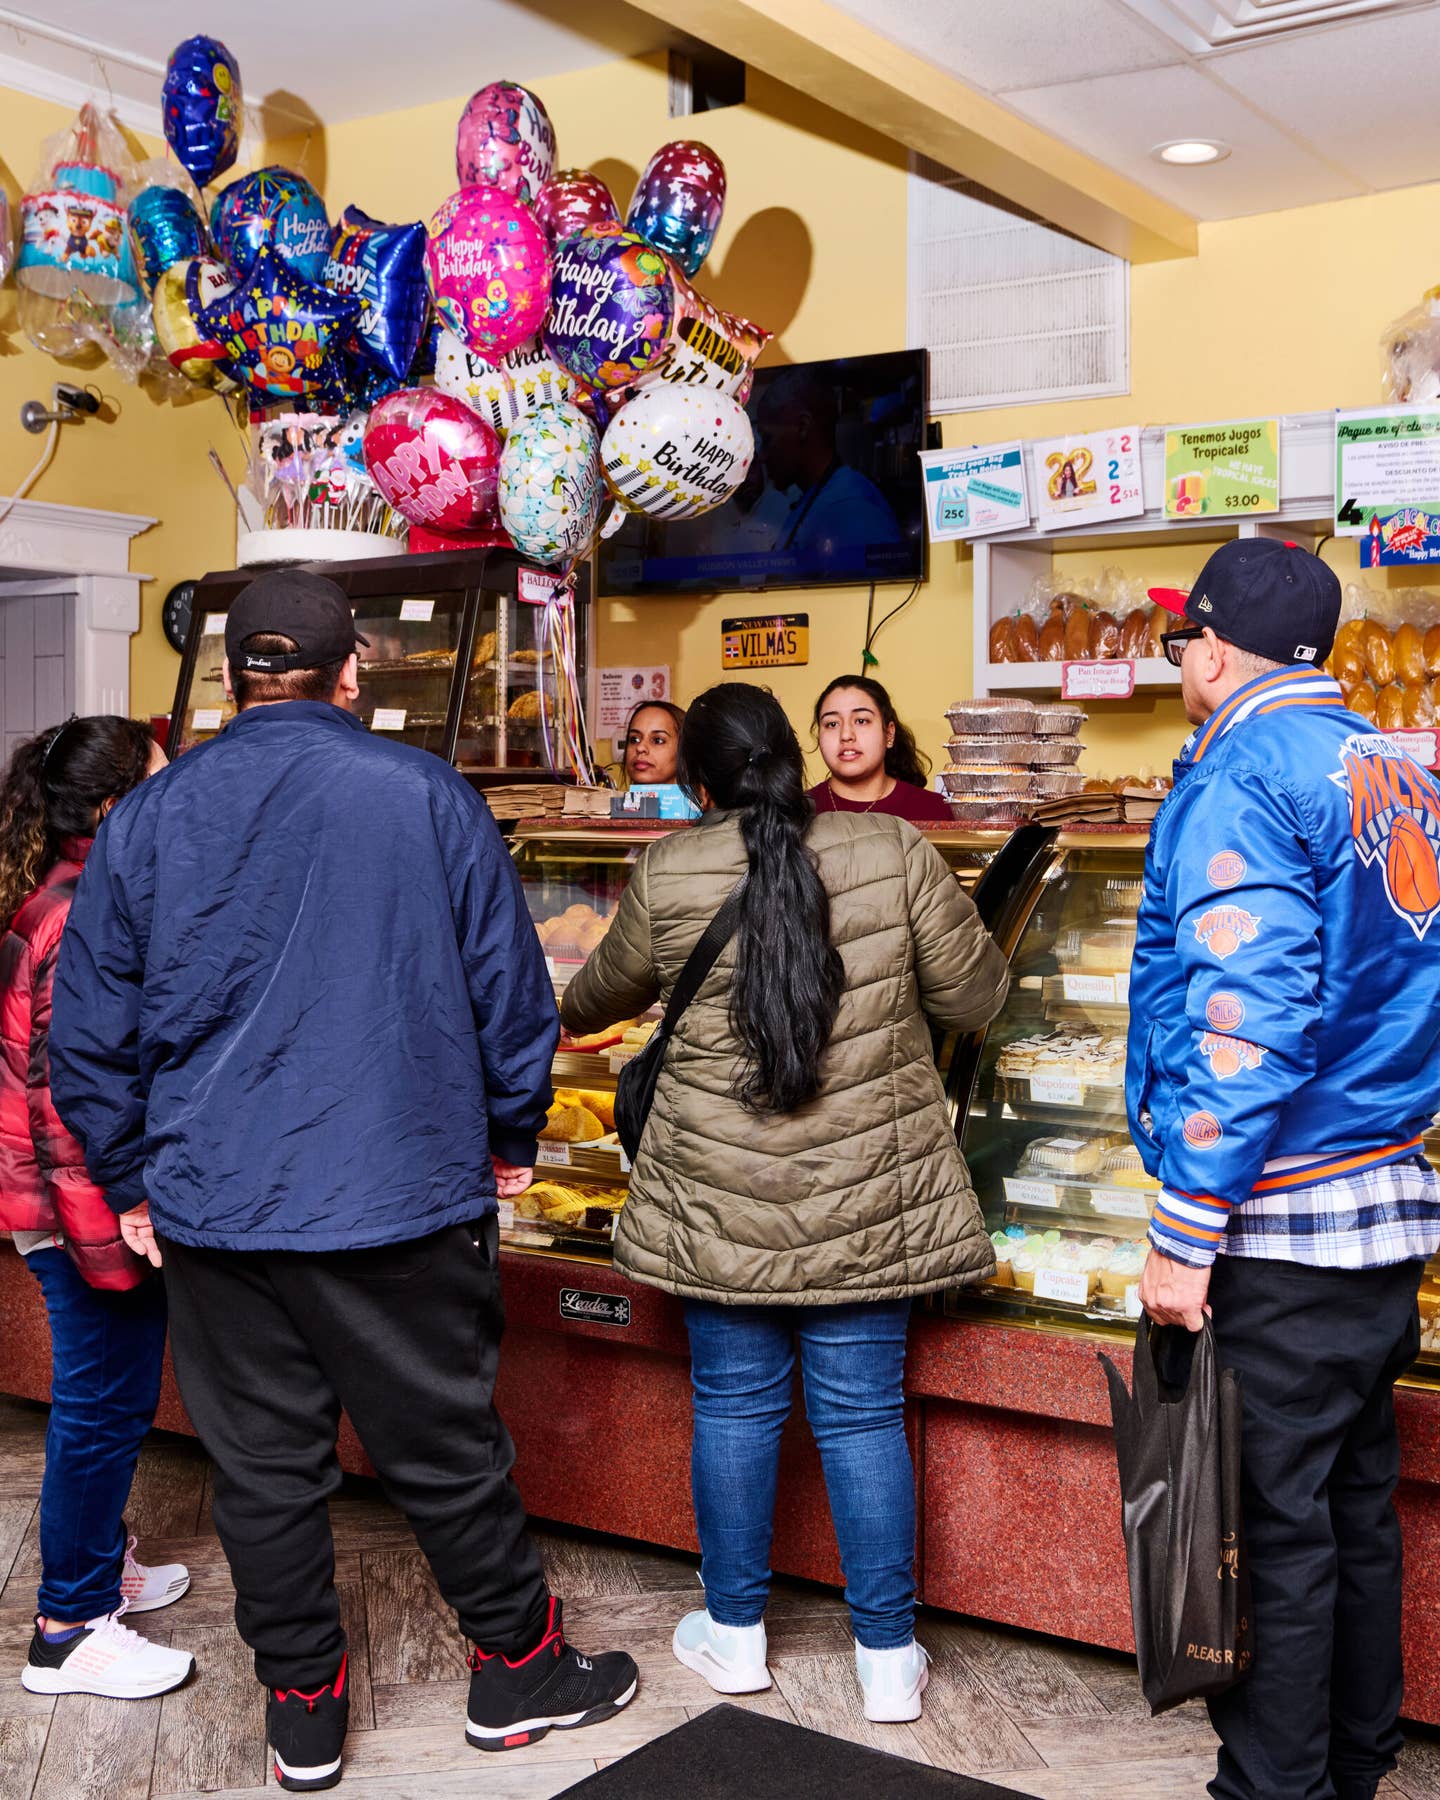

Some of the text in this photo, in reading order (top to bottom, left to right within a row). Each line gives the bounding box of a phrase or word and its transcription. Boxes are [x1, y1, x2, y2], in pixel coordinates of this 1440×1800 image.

[283, 213, 328, 242] Happy
[447, 236, 486, 263] Happy
[437, 253, 496, 281] Birthday
[553, 250, 618, 304] Happy
[229, 295, 304, 331] HAPPY
[225, 320, 334, 359] BIRTHDAY
[685, 318, 745, 383] HAPPY
[1181, 428, 1262, 446] Tenemos Jugos
[1375, 425, 1389, 434] en
[1120, 434, 1132, 453] 2
[1193, 444, 1250, 461] Tropicales
[691, 437, 745, 472] HAPPY
[371, 430, 443, 503] APPY
[653, 440, 738, 504] Birthday
[1107, 459, 1120, 480] 2
[1109, 485, 1121, 505] 2
[1225, 494, 1260, 508] $3.00
[944, 509, 964, 520] 25¢
[1381, 507, 1430, 545] MUSICAL
[742, 618, 787, 630] NEW YORK
[740, 629, 797, 658] VILMA'S
[749, 658, 779, 666] BAKERY
[1391, 735, 1435, 744] Mantequilla
[1211, 860, 1240, 880] KNICKS
[1196, 911, 1258, 939] KNICKS
[1209, 1003, 1239, 1021] KNICKS
[1031, 1076, 1080, 1090] Napoleon
[1187, 1120, 1217, 1139] KNICKS
[538, 1143, 567, 1154] roissant
[1042, 1271, 1082, 1287] Cupcake
[1186, 1643, 1223, 1664] PLEAS
